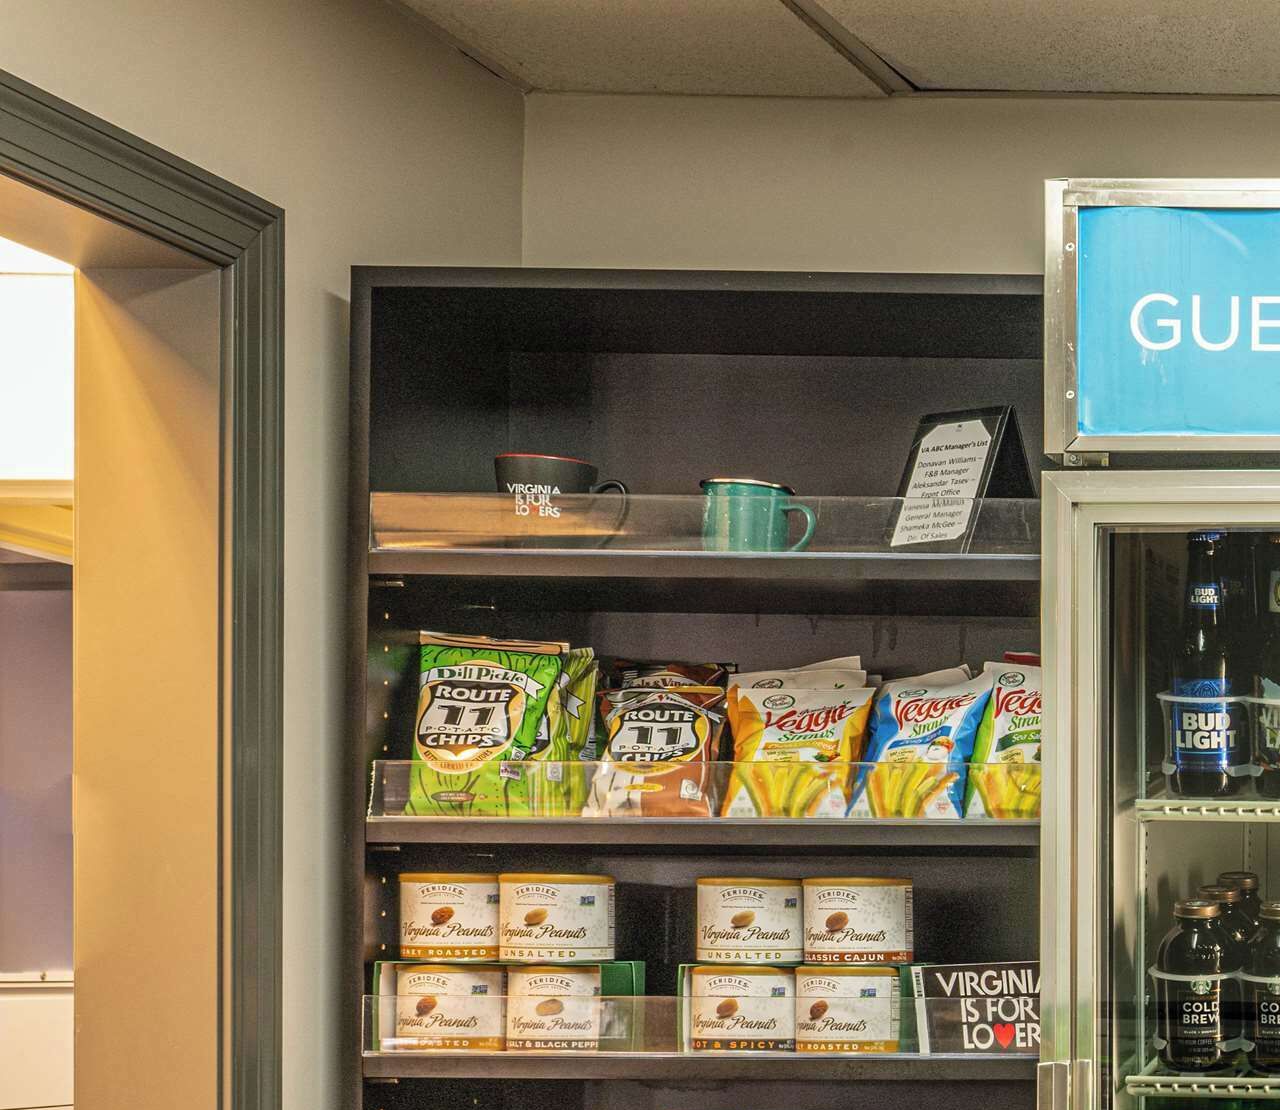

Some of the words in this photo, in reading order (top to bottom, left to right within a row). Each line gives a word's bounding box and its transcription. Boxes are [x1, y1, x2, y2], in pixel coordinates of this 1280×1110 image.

[945, 441, 976, 451] Manager's
[976, 439, 989, 448] List
[940, 467, 970, 477] Manager
[507, 482, 561, 495] VIRGINIA
[515, 505, 561, 519] LOERS
[1193, 587, 1215, 596] BUD
[1190, 594, 1219, 604] LIGHT
[436, 666, 473, 681] Dill
[476, 667, 525, 684] Pickle
[435, 684, 512, 702] ROUTE
[437, 703, 496, 728] 11
[1182, 712, 1231, 731] BUD
[425, 734, 495, 748] CHIPS
[1175, 730, 1237, 749] LIGHT
[442, 922, 496, 939] Peanuts
[428, 948, 488, 957] ROASTED
[707, 951, 783, 961] UNSALTED
[843, 952, 885, 962] CAJUN
[960, 998, 981, 1025] IS
[986, 996, 1040, 1023] FOR
[1182, 1001, 1220, 1013] COLD
[1182, 1013, 1220, 1025] BREW
[961, 1021, 1041, 1051] LOER
[534, 1040, 568, 1049] BLACK
[728, 1039, 777, 1050] SPICY
